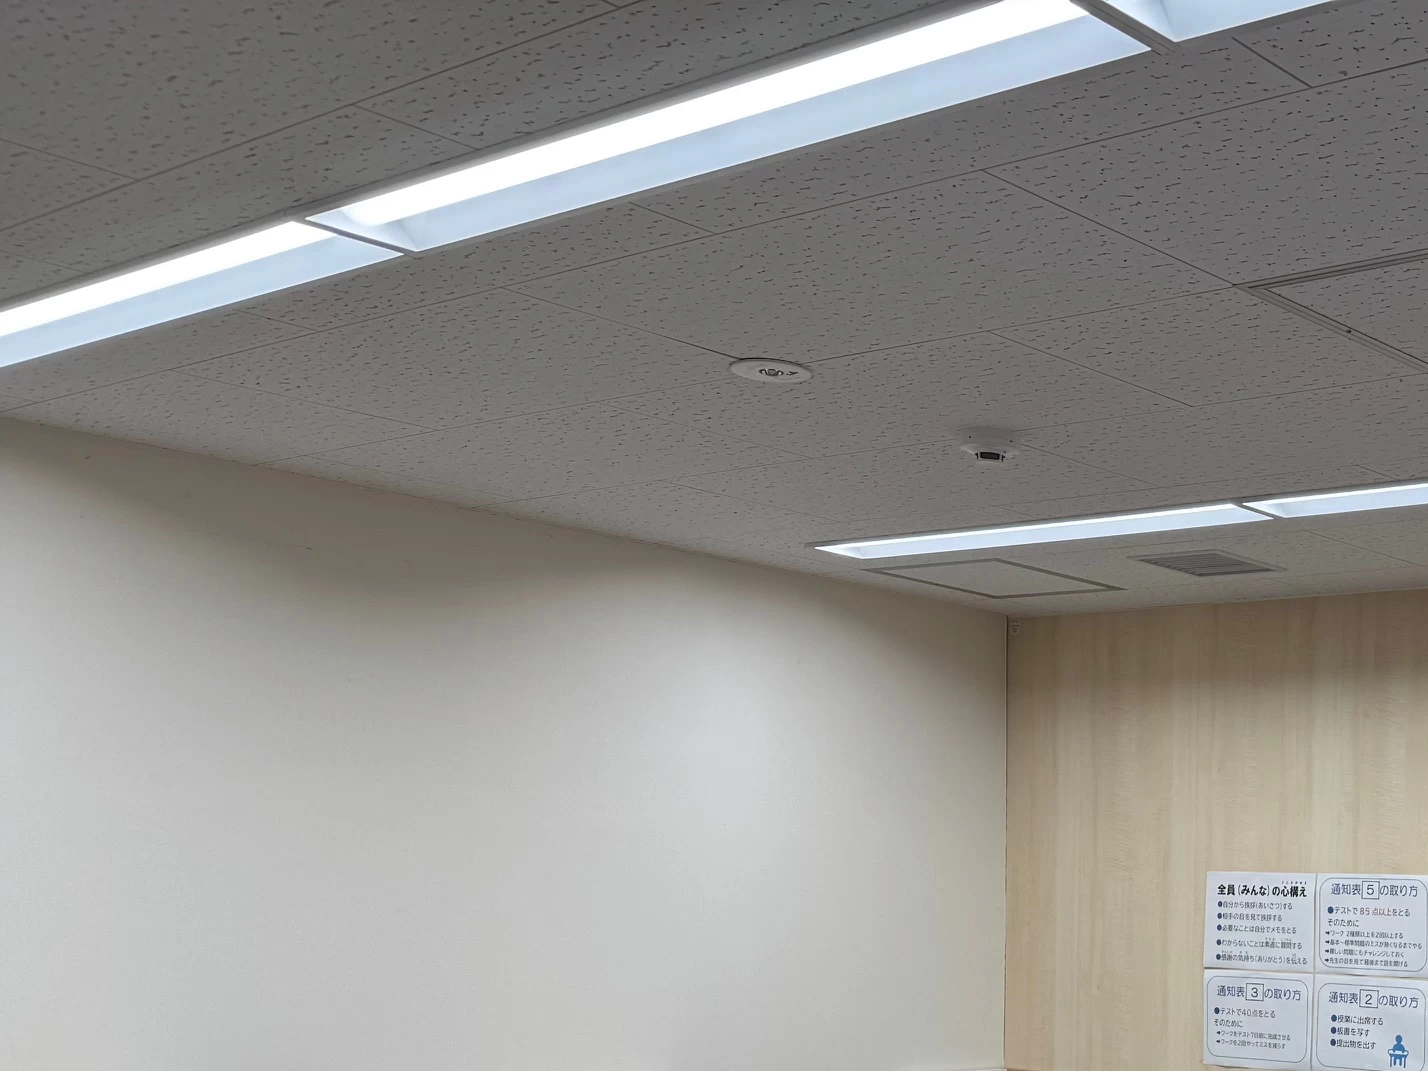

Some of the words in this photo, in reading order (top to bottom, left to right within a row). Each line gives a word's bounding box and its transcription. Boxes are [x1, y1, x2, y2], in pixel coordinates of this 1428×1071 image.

[1328, 919, 1359, 927] そのために
[1214, 1019, 1243, 1027] そのために
[1338, 1015, 1383, 1025] 授業に出席する
[1337, 1027, 1370, 1037] 板書を写す
[1337, 1039, 1376, 1049] 提出物を出す
